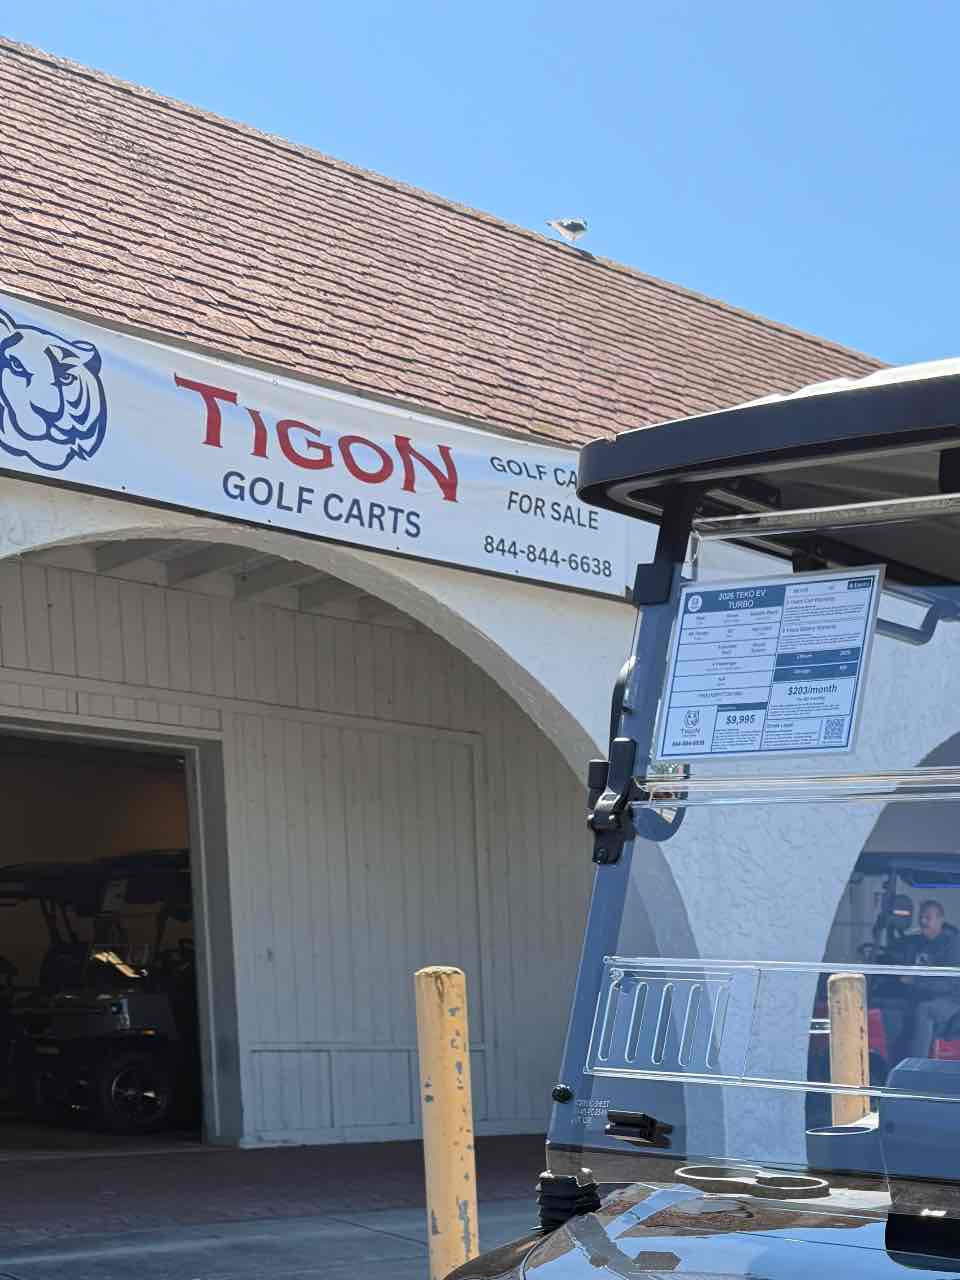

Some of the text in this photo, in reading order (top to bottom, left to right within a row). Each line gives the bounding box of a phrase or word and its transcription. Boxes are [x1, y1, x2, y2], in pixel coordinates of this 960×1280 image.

[173, 372, 459, 503] TIGON
[490, 456, 548, 481] GOLF
[222, 470, 422, 538] GOLF CARTS
[507, 490, 599, 530] FOR SALE
[483, 535, 613, 577] 844-844-6638
[728, 599, 754, 609] TURBO
[726, 714, 756, 726] $9,995
